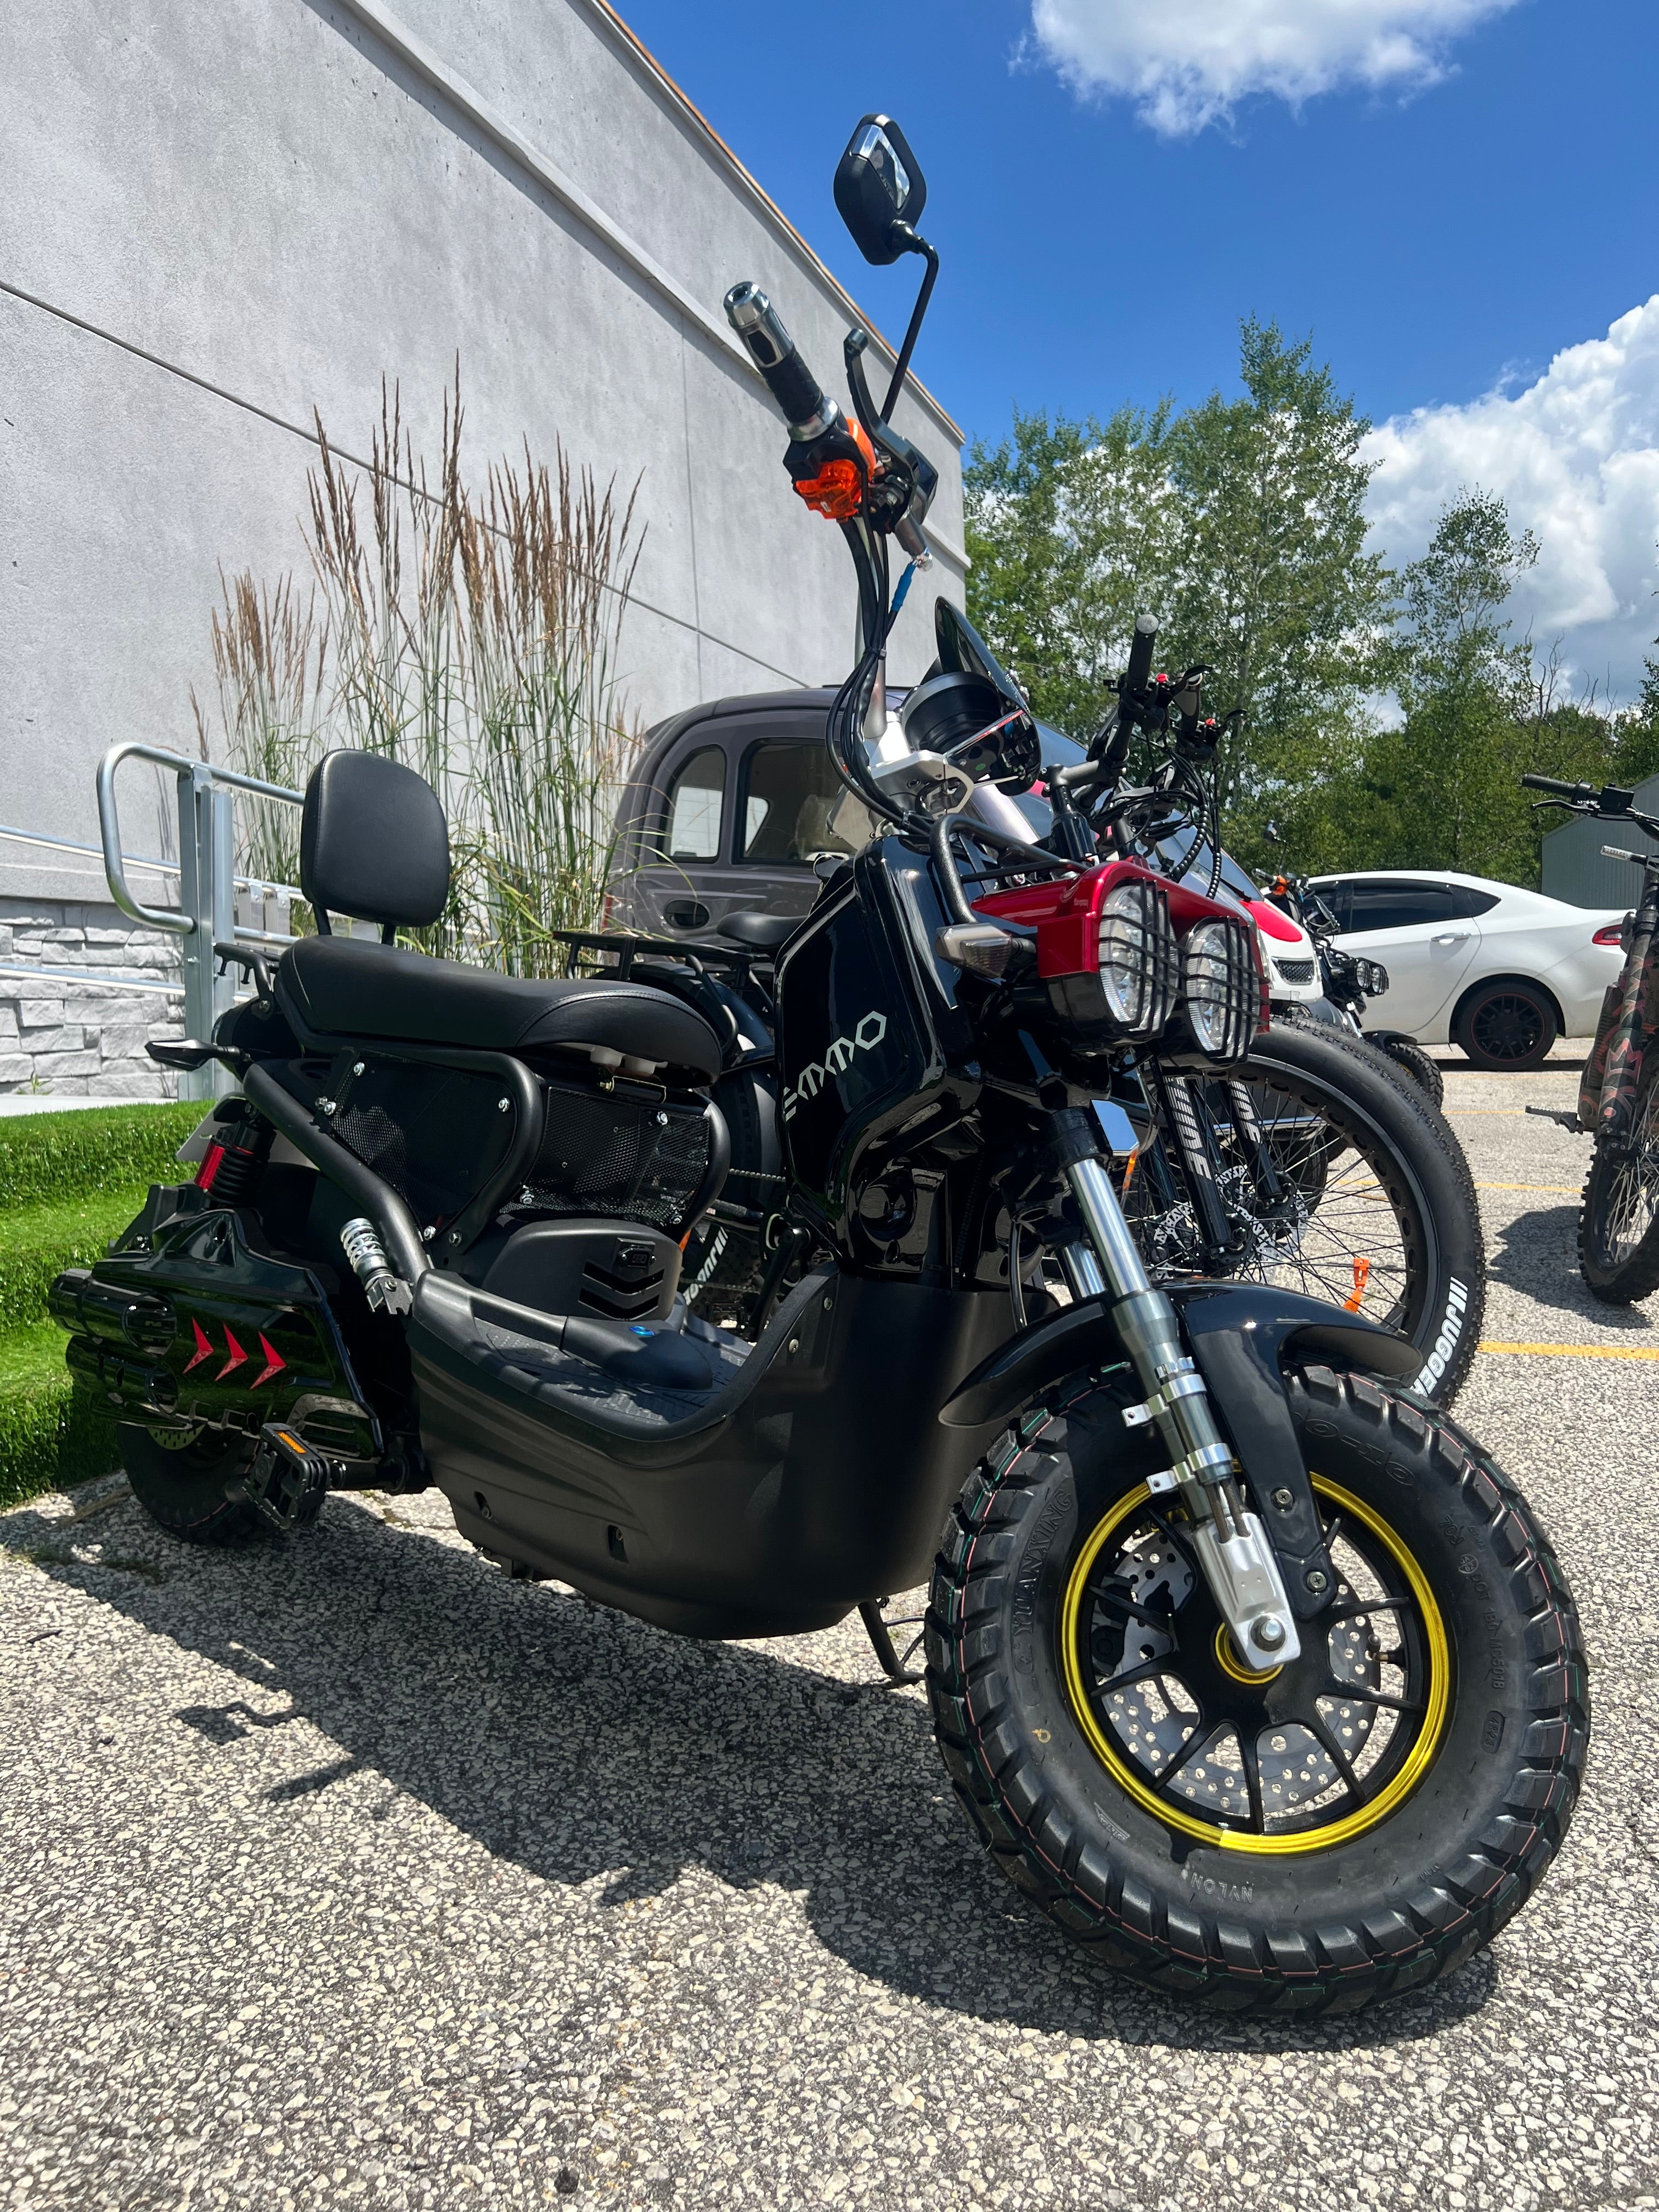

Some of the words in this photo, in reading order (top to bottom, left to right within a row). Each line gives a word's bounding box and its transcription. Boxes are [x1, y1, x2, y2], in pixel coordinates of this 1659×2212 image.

[782, 1011, 887, 1122] EMMO
[1013, 1488, 1073, 1635] YUANXING
[1471, 1573, 1491, 1600] DOT
[1190, 1871, 1253, 1904] NYLON
